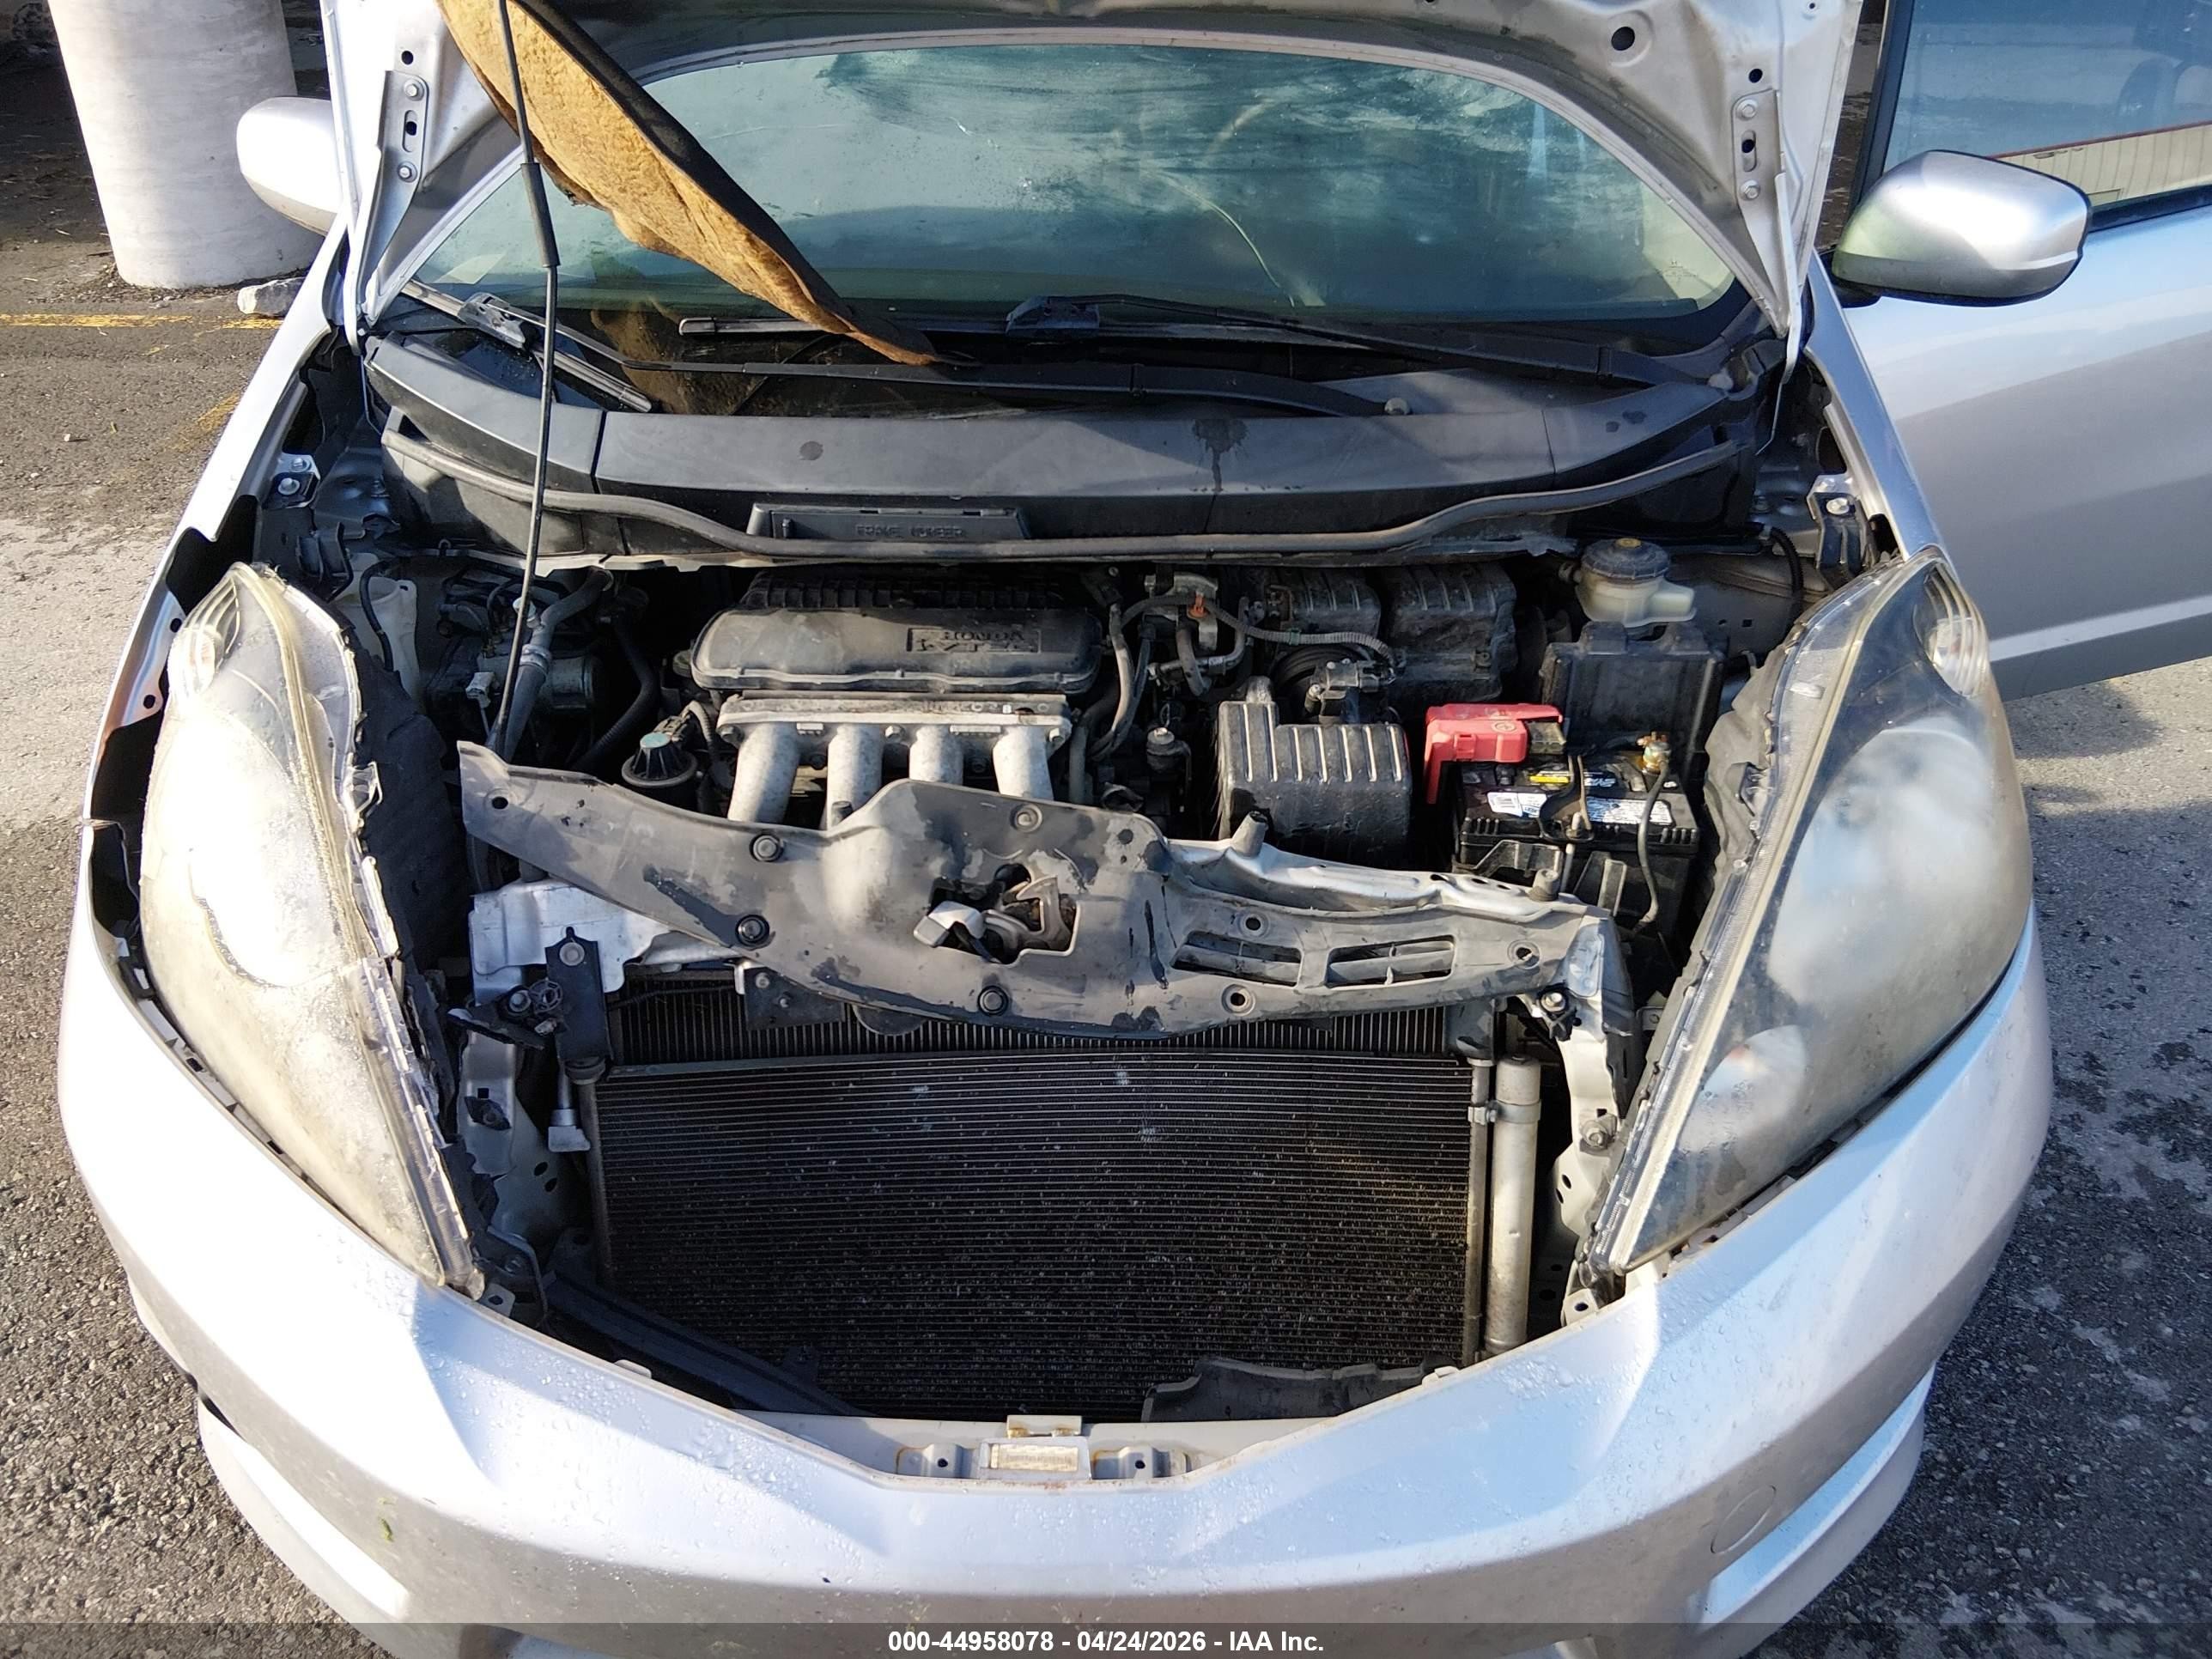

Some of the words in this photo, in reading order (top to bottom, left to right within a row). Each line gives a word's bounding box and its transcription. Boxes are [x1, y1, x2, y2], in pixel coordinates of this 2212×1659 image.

[854, 524, 902, 538] FRAME
[909, 525, 964, 538] NUMBER
[940, 630, 1025, 641] HONDA
